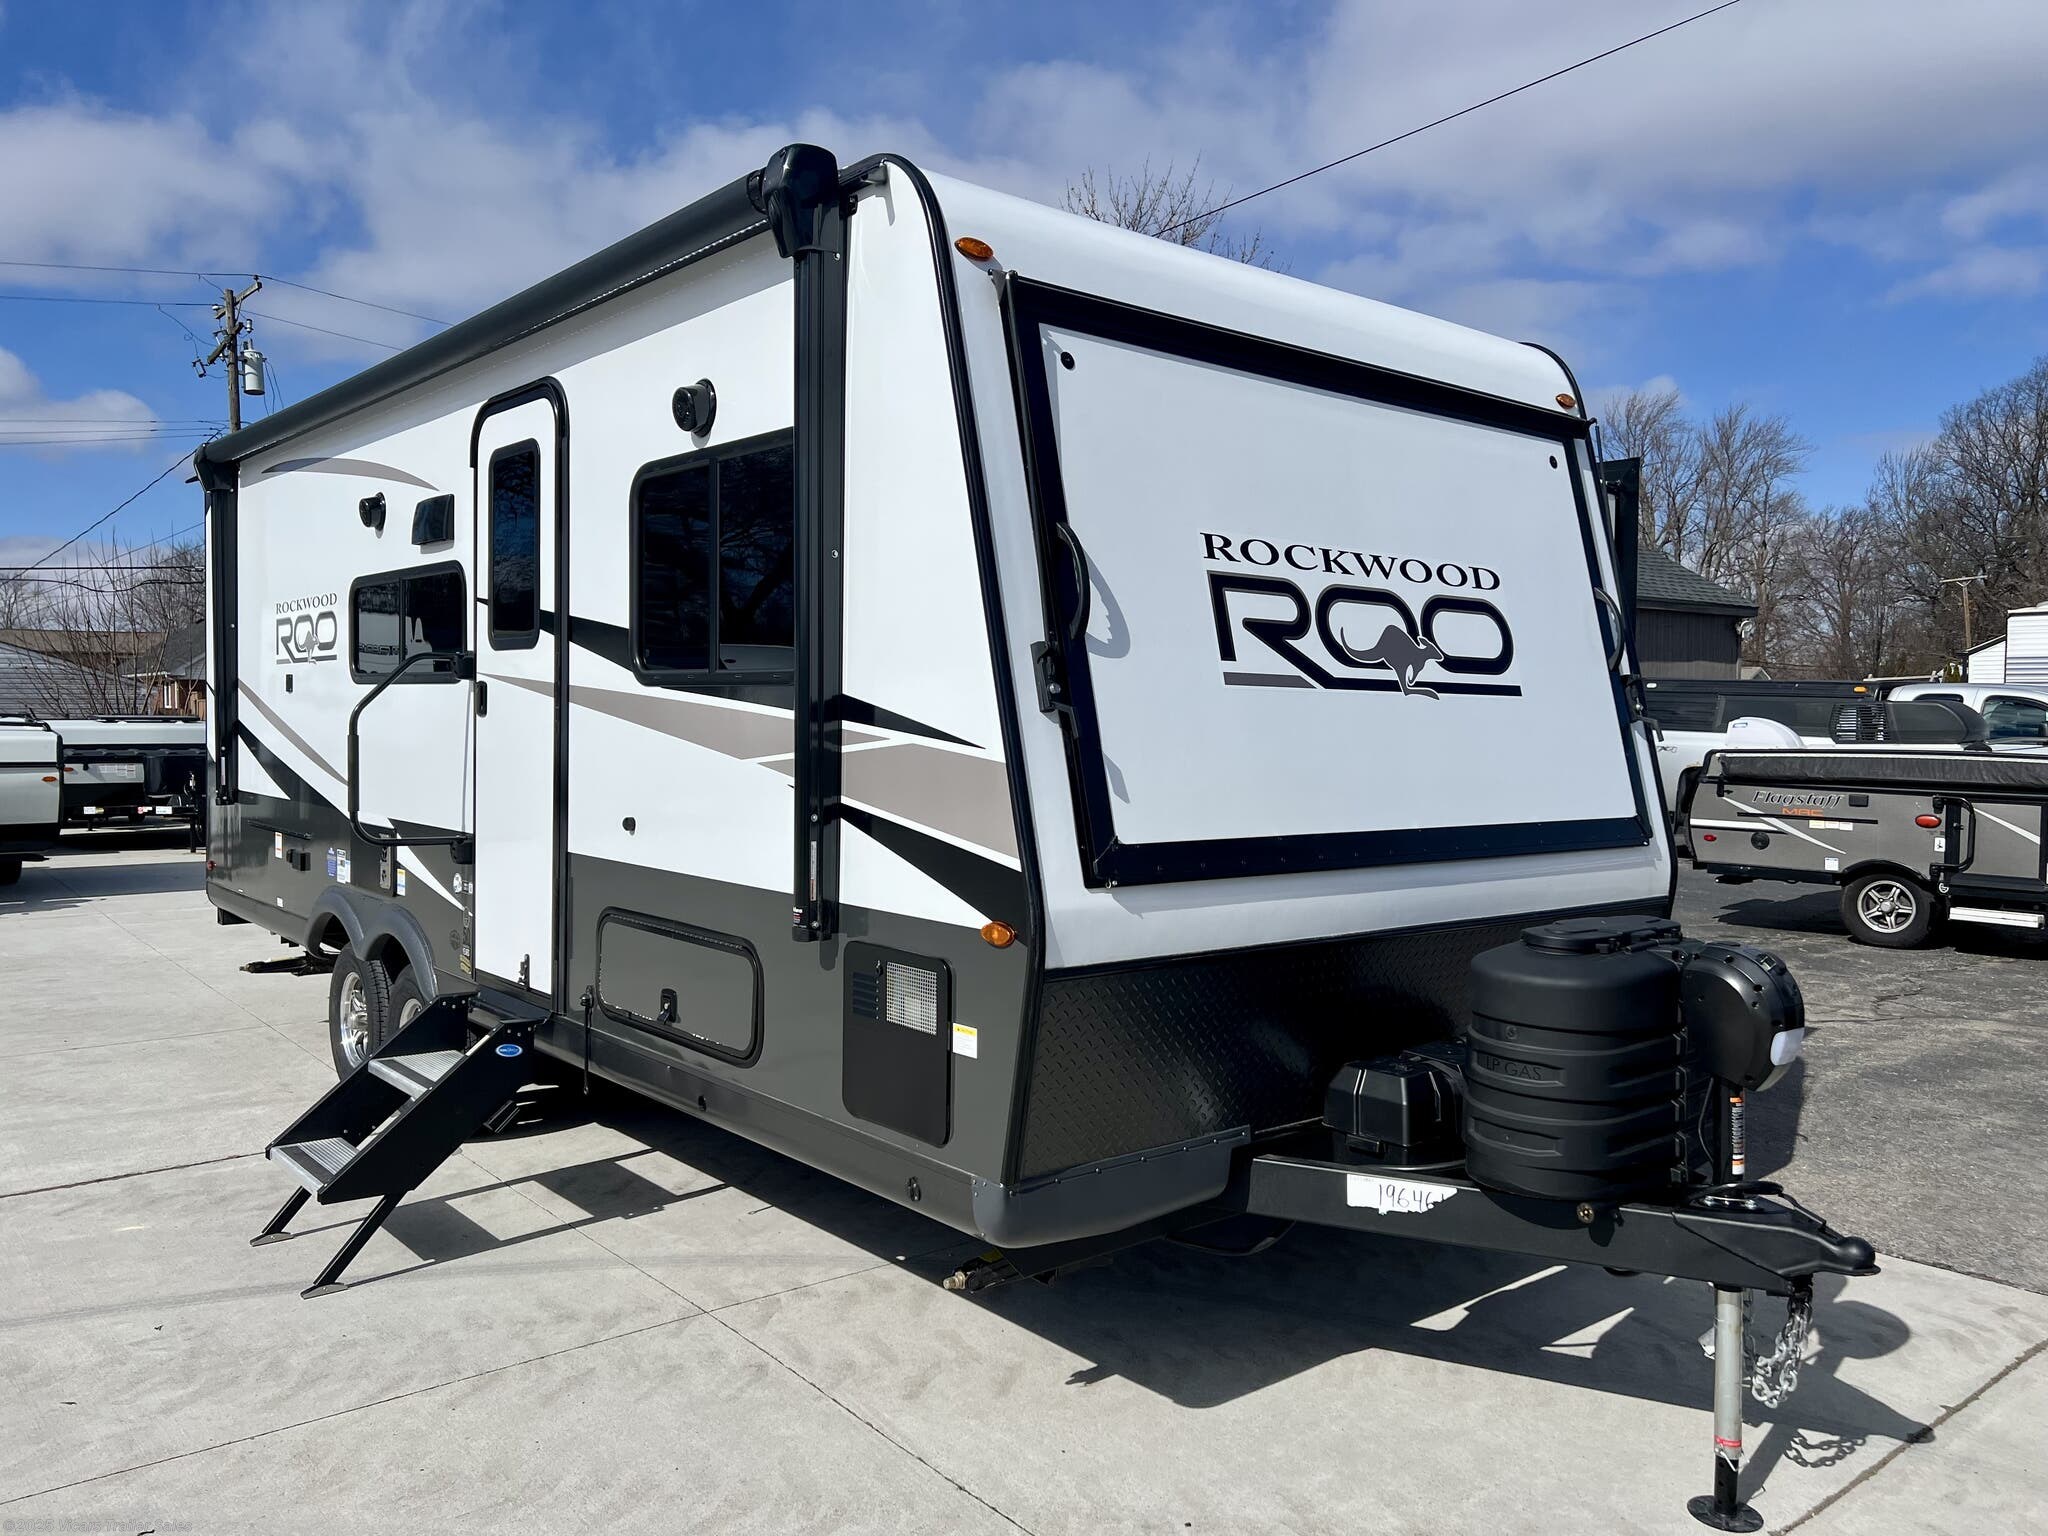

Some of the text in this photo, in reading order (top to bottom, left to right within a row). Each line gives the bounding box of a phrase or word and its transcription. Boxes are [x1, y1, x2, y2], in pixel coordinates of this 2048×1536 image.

[1200, 532, 1501, 591] ROCKWOOD
[276, 593, 338, 615] ROCKWOOD
[276, 610, 338, 664] ROO
[1207, 569, 1522, 697] ROO
[1752, 790, 1845, 809] Flagstaff
[1504, 1062, 1543, 1081] GAS
